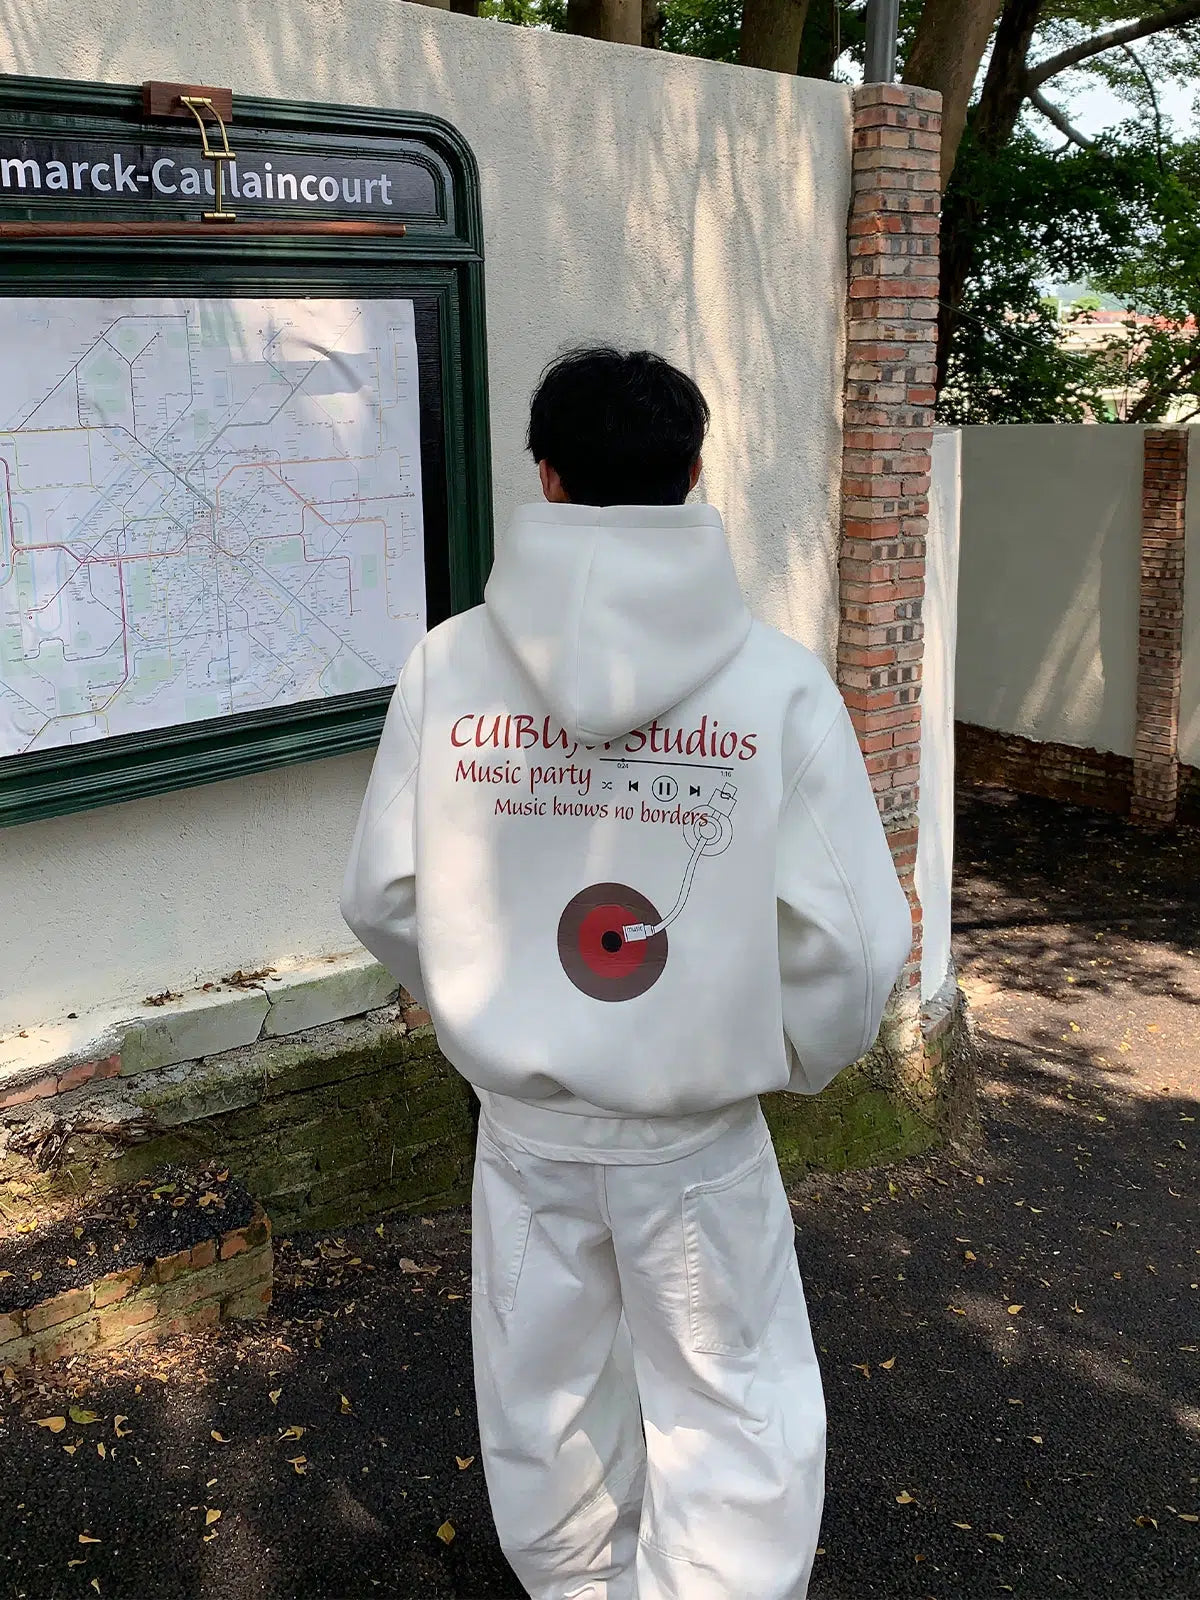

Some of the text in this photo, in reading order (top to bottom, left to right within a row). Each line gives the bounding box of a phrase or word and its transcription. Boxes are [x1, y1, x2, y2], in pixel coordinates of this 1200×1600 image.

[624, 714, 758, 761] Studios
[455, 760, 592, 796] Music party
[494, 796, 709, 828] Music knows no borders
